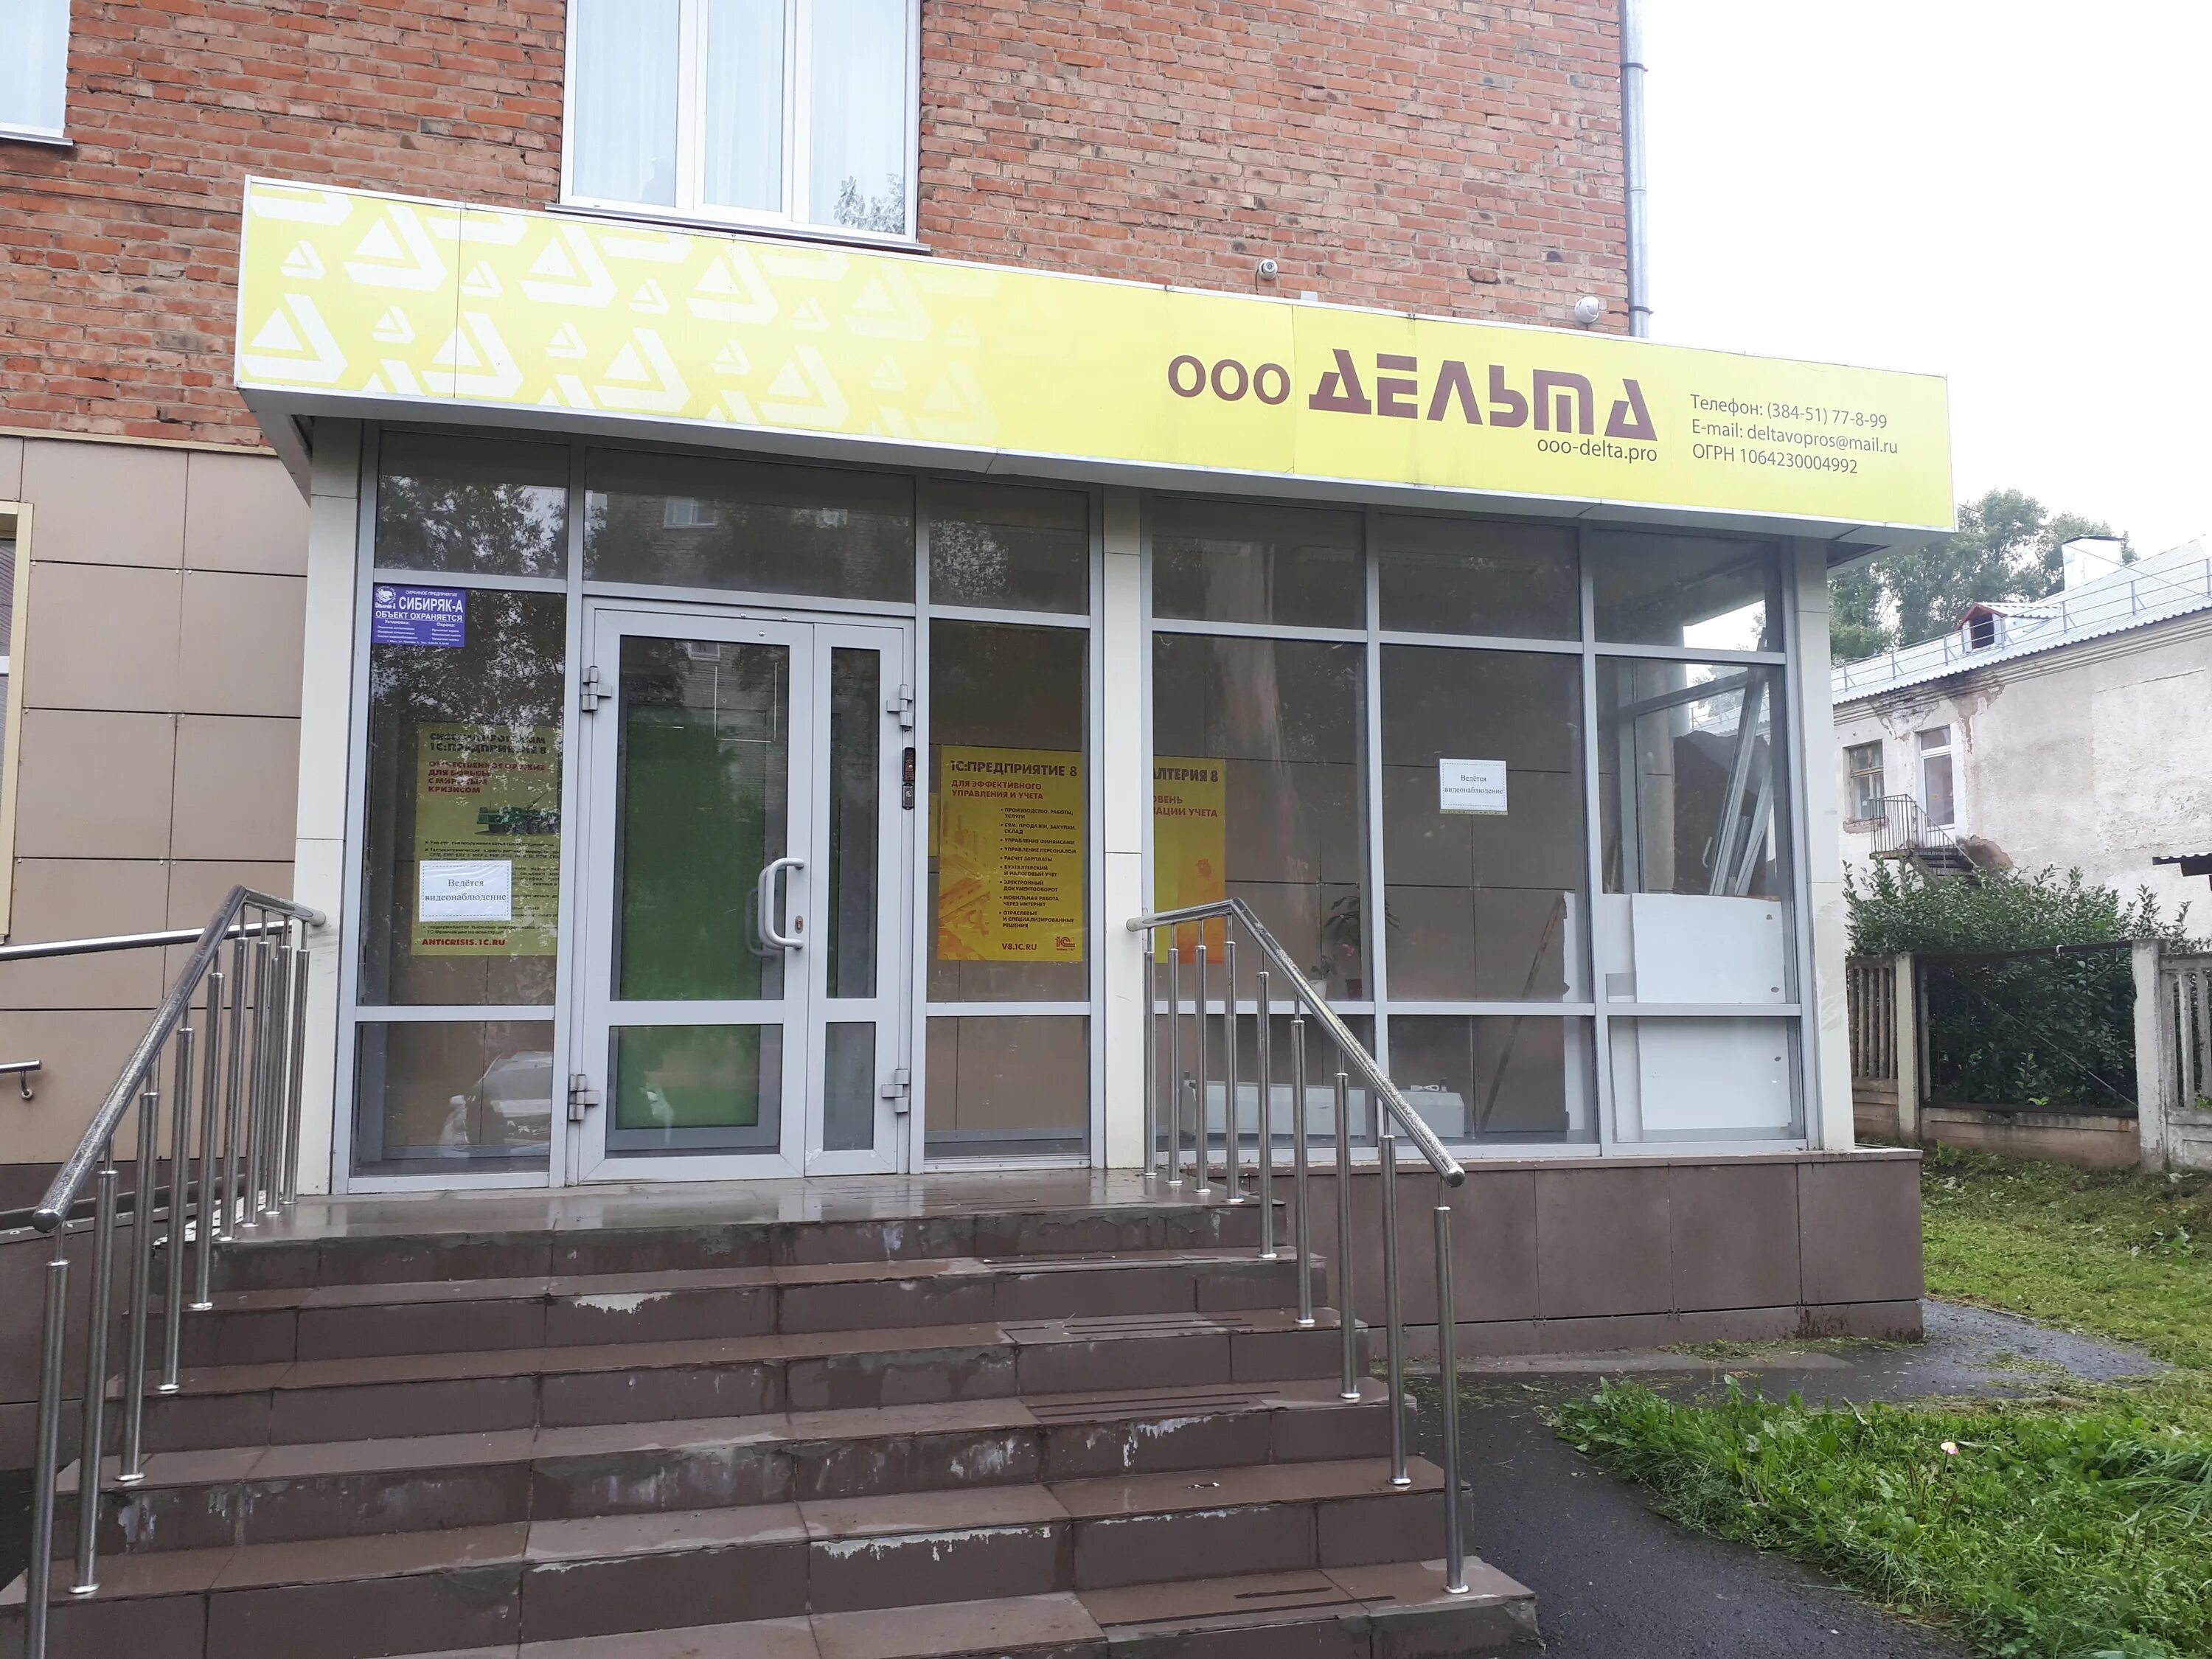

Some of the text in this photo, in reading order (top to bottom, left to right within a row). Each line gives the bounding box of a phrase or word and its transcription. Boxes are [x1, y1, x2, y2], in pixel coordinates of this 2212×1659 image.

[1167, 355, 1291, 406] ООО
[1689, 394, 1888, 428] Телефон: (384-51) 77-8-99
[1691, 418, 1898, 454] E-mail: deltavopros@mail.ru
[1537, 438, 1658, 463] ooo-delta.pro
[1692, 443, 1858, 474] ОГРН 1064230004992
[398, 596, 464, 613] СИБИРЯК-А
[375, 611, 463, 622] ОБЪЕКТ ОХРАНЯЕТСЯ
[950, 760, 1078, 776] 1С:ПРЕДПРИЯТИЕ 8
[1210, 770, 1219, 782] 8
[1461, 774, 1487, 782] Ведётся
[951, 780, 1042, 790] ДЛЯ ЭФФЕКТИВНОГО
[952, 790, 1008, 798] УПРАВЛЕНИЯ
[1188, 808, 1218, 817] УЧЕТА
[448, 878, 484, 887] Ведётся
[425, 893, 507, 901] видеонаблюдение
